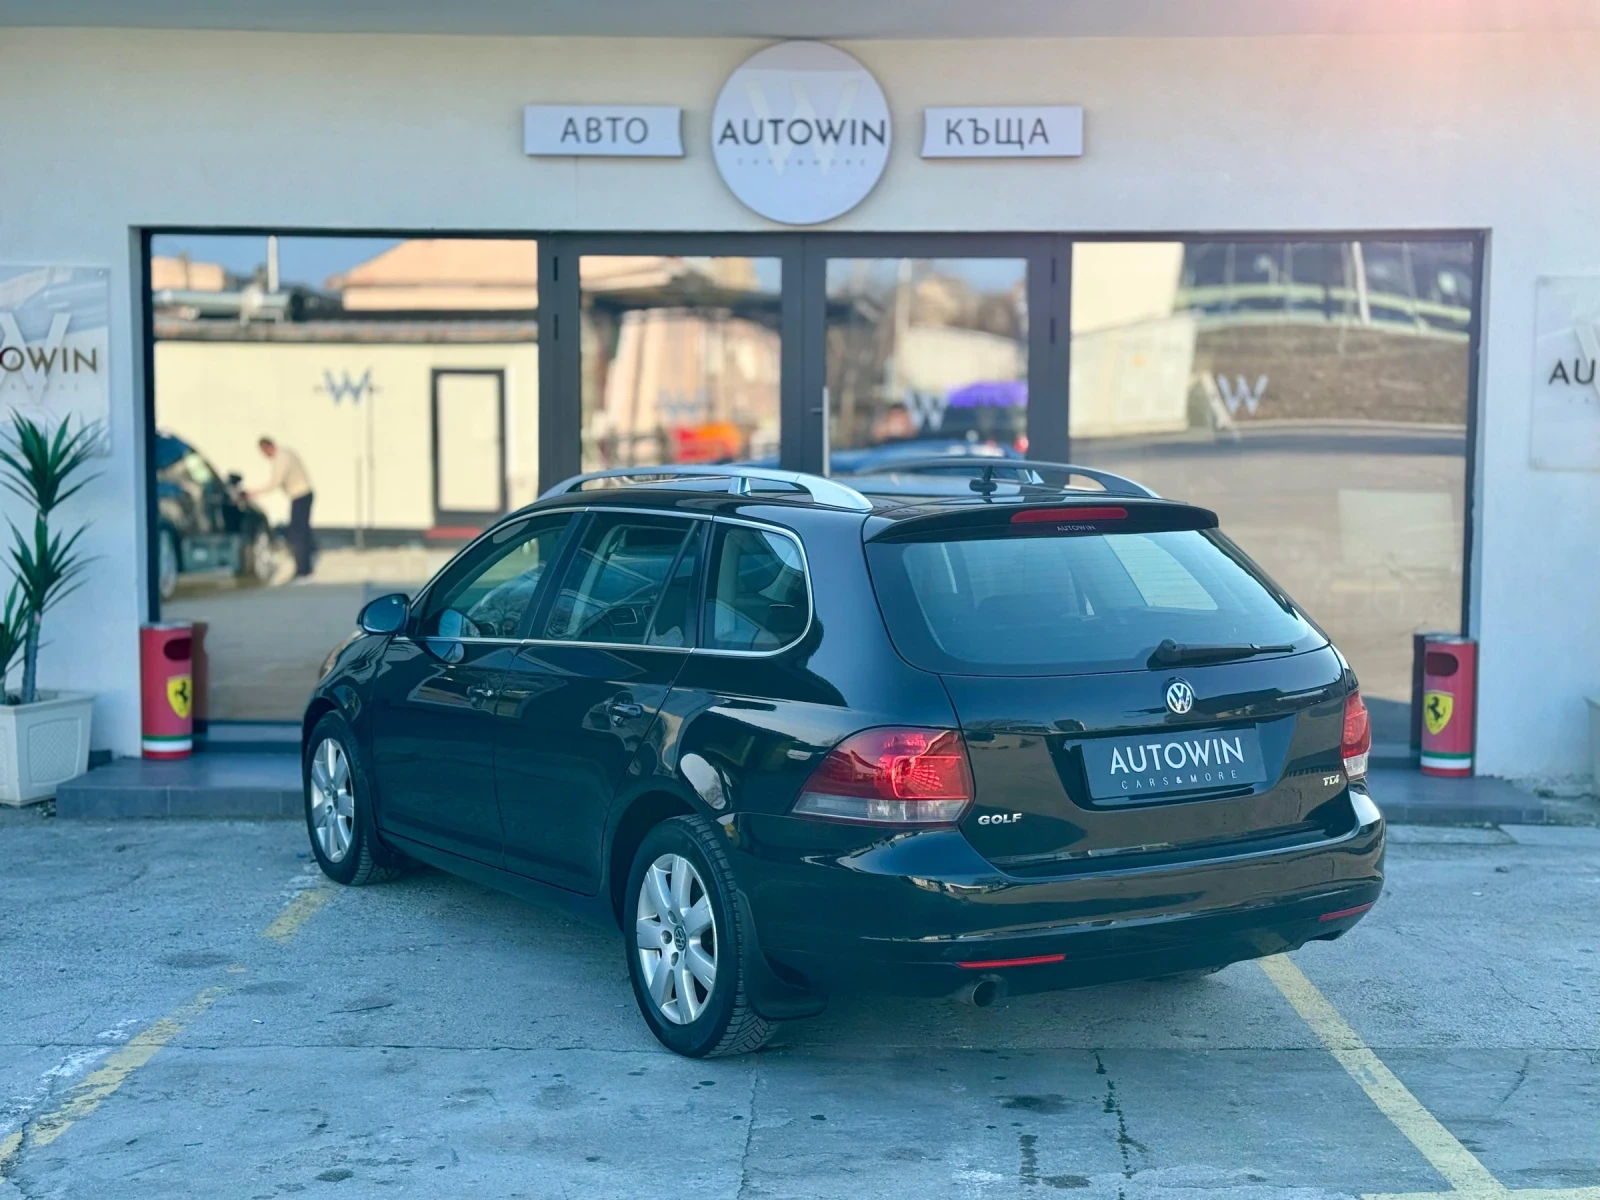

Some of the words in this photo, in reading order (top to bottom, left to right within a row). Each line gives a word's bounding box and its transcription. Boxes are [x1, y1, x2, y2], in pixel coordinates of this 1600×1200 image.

[560, 117, 648, 144] АВТО
[718, 119, 886, 146] AUTOWIN
[945, 118, 1049, 150] КЪЩА
[1549, 358, 1596, 385] AU
[322, 367, 372, 406] W
[1218, 374, 1269, 416] W
[1056, 524, 1096, 532] AUTOWIN
[1110, 737, 1245, 775] AUTOWIN
[977, 813, 1023, 825] GOLF
